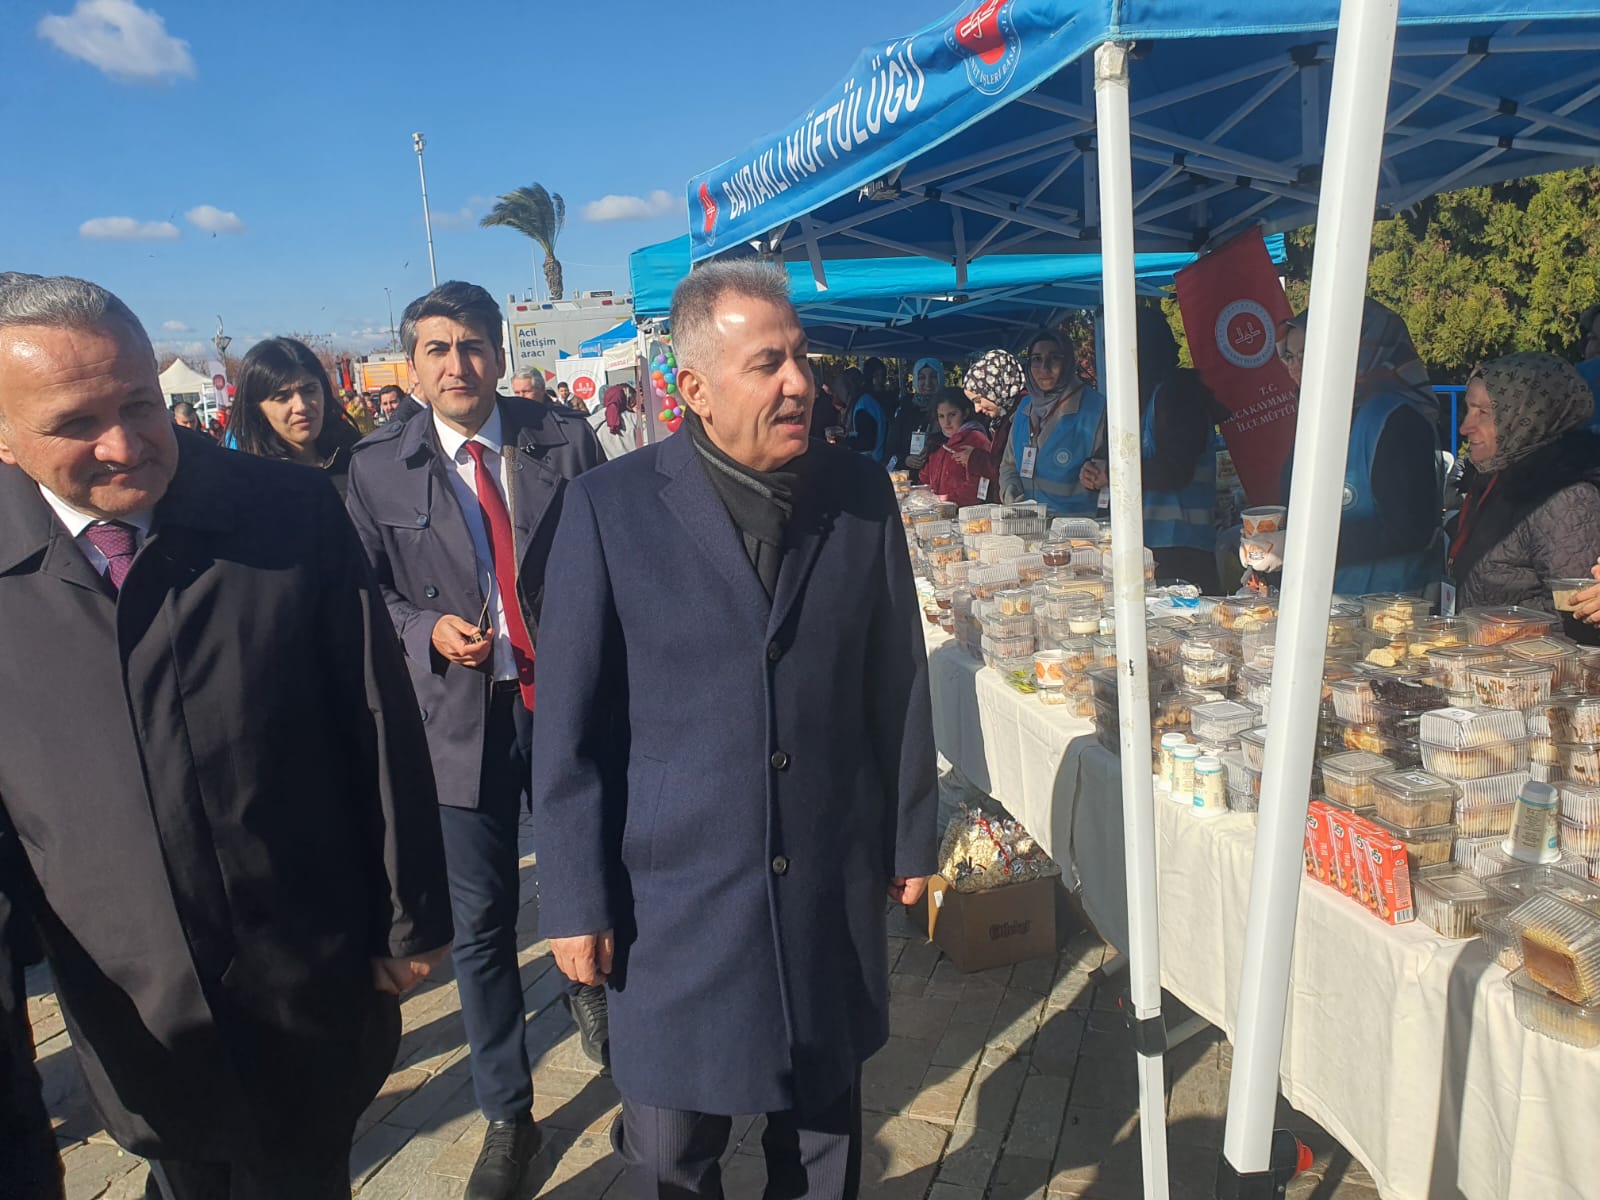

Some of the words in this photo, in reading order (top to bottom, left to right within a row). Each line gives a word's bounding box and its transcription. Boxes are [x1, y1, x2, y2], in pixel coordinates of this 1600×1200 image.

[721, 141, 793, 220] BAYRAKLI
[785, 36, 926, 183] MÜFTÜLÜĞÜ
[519, 328, 536, 337] Acil
[520, 338, 556, 347] iletişim
[1259, 383, 1278, 396] T.C.
[1235, 417, 1259, 433] İLÇE
